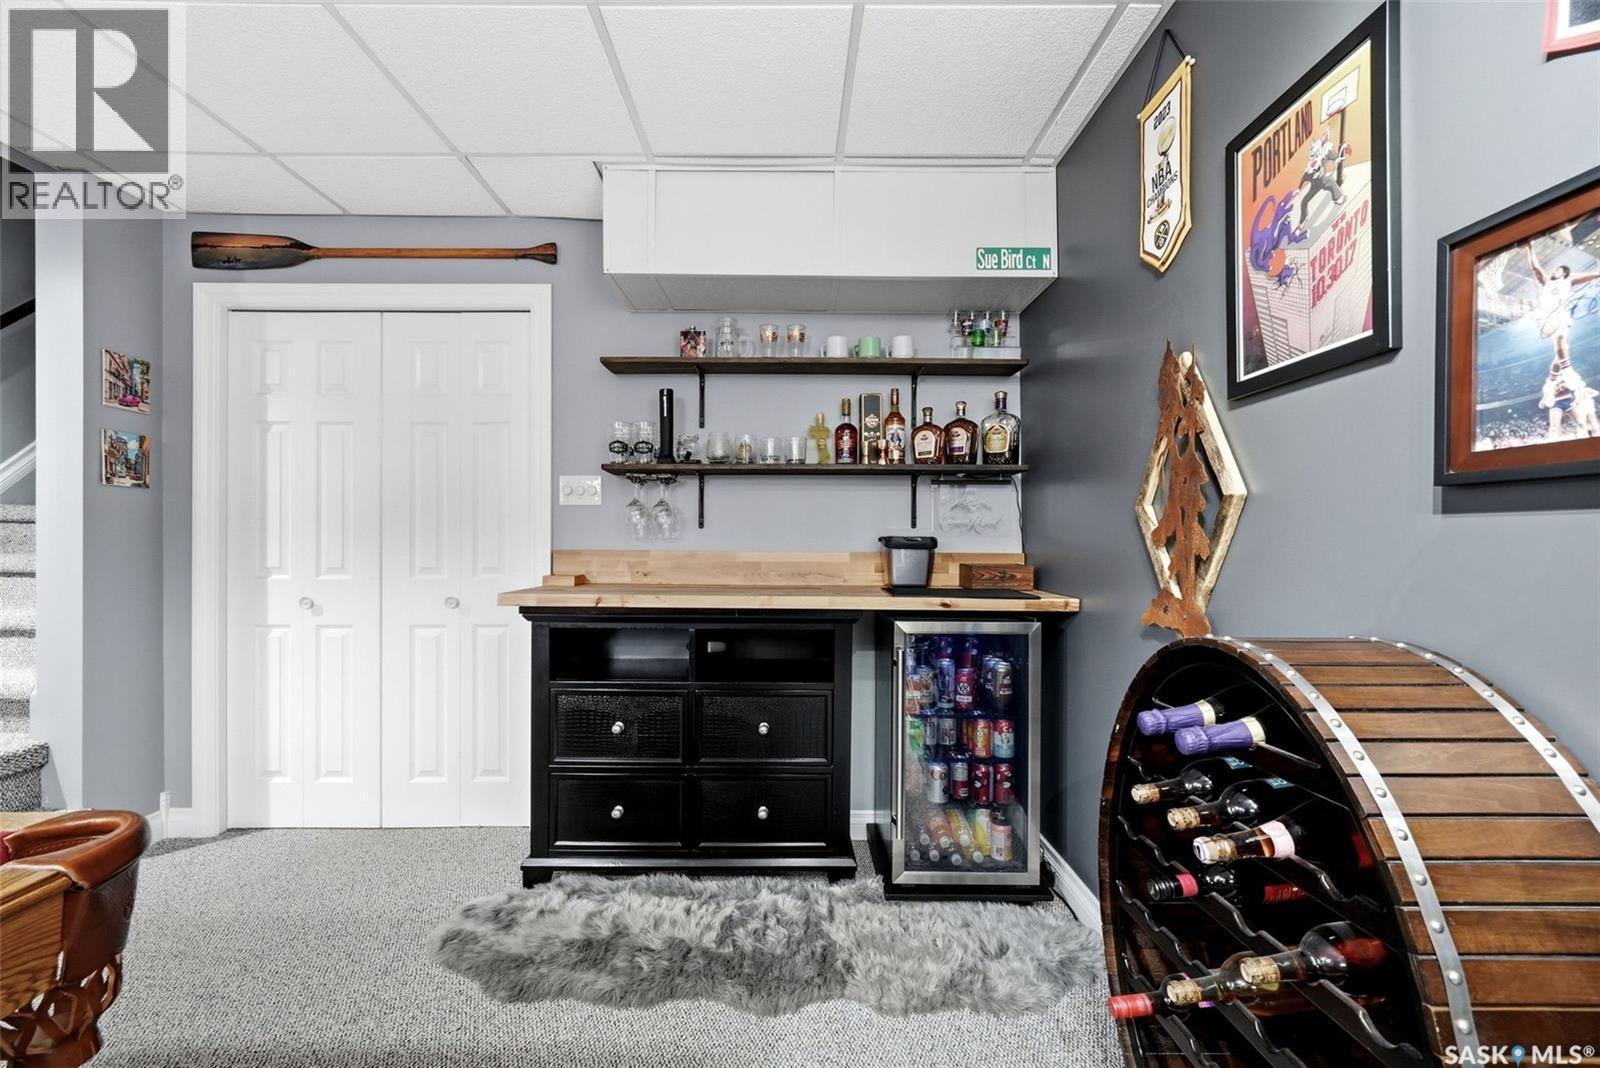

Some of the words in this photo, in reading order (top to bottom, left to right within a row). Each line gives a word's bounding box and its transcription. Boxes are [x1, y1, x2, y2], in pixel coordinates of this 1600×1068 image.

[1153, 101, 1171, 130] 2023
[1251, 100, 1313, 203] PORTLAND
[1146, 170, 1178, 208] CHAMPIONS
[1151, 161, 1172, 194] NBA
[977, 248, 998, 269] Sue
[1000, 248, 1024, 269] Bird
[1042, 254, 1050, 269] N
[1310, 199, 1370, 283] TORONTO
